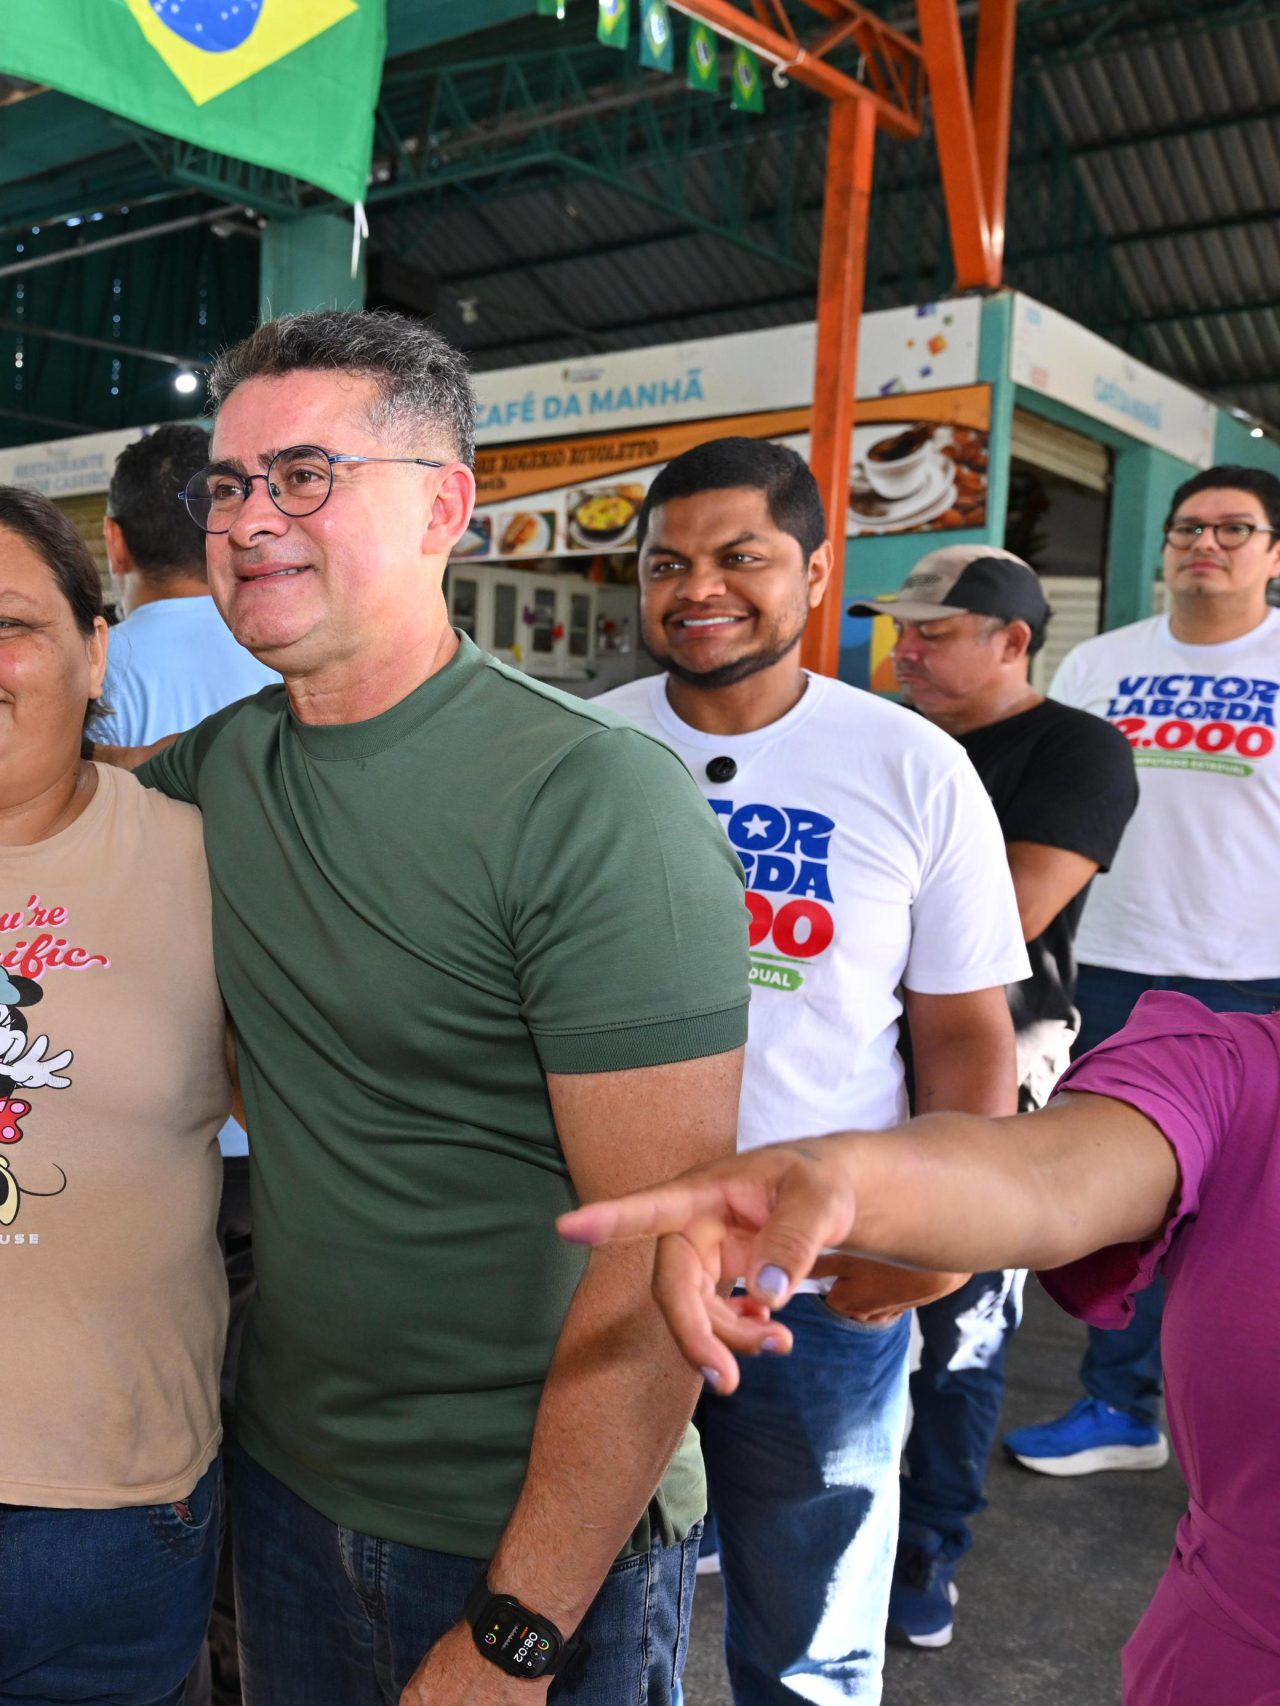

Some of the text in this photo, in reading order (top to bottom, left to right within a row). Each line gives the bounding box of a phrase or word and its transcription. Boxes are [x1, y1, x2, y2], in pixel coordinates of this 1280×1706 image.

[543, 394, 581, 420] DA
[589, 368, 704, 414] MANHÃ
[1117, 674, 1280, 704] VICTOR
[1106, 698, 1277, 728] LABORDA
[1110, 717, 1275, 758] 2.000
[513, 1632, 538, 1662] 08:02
